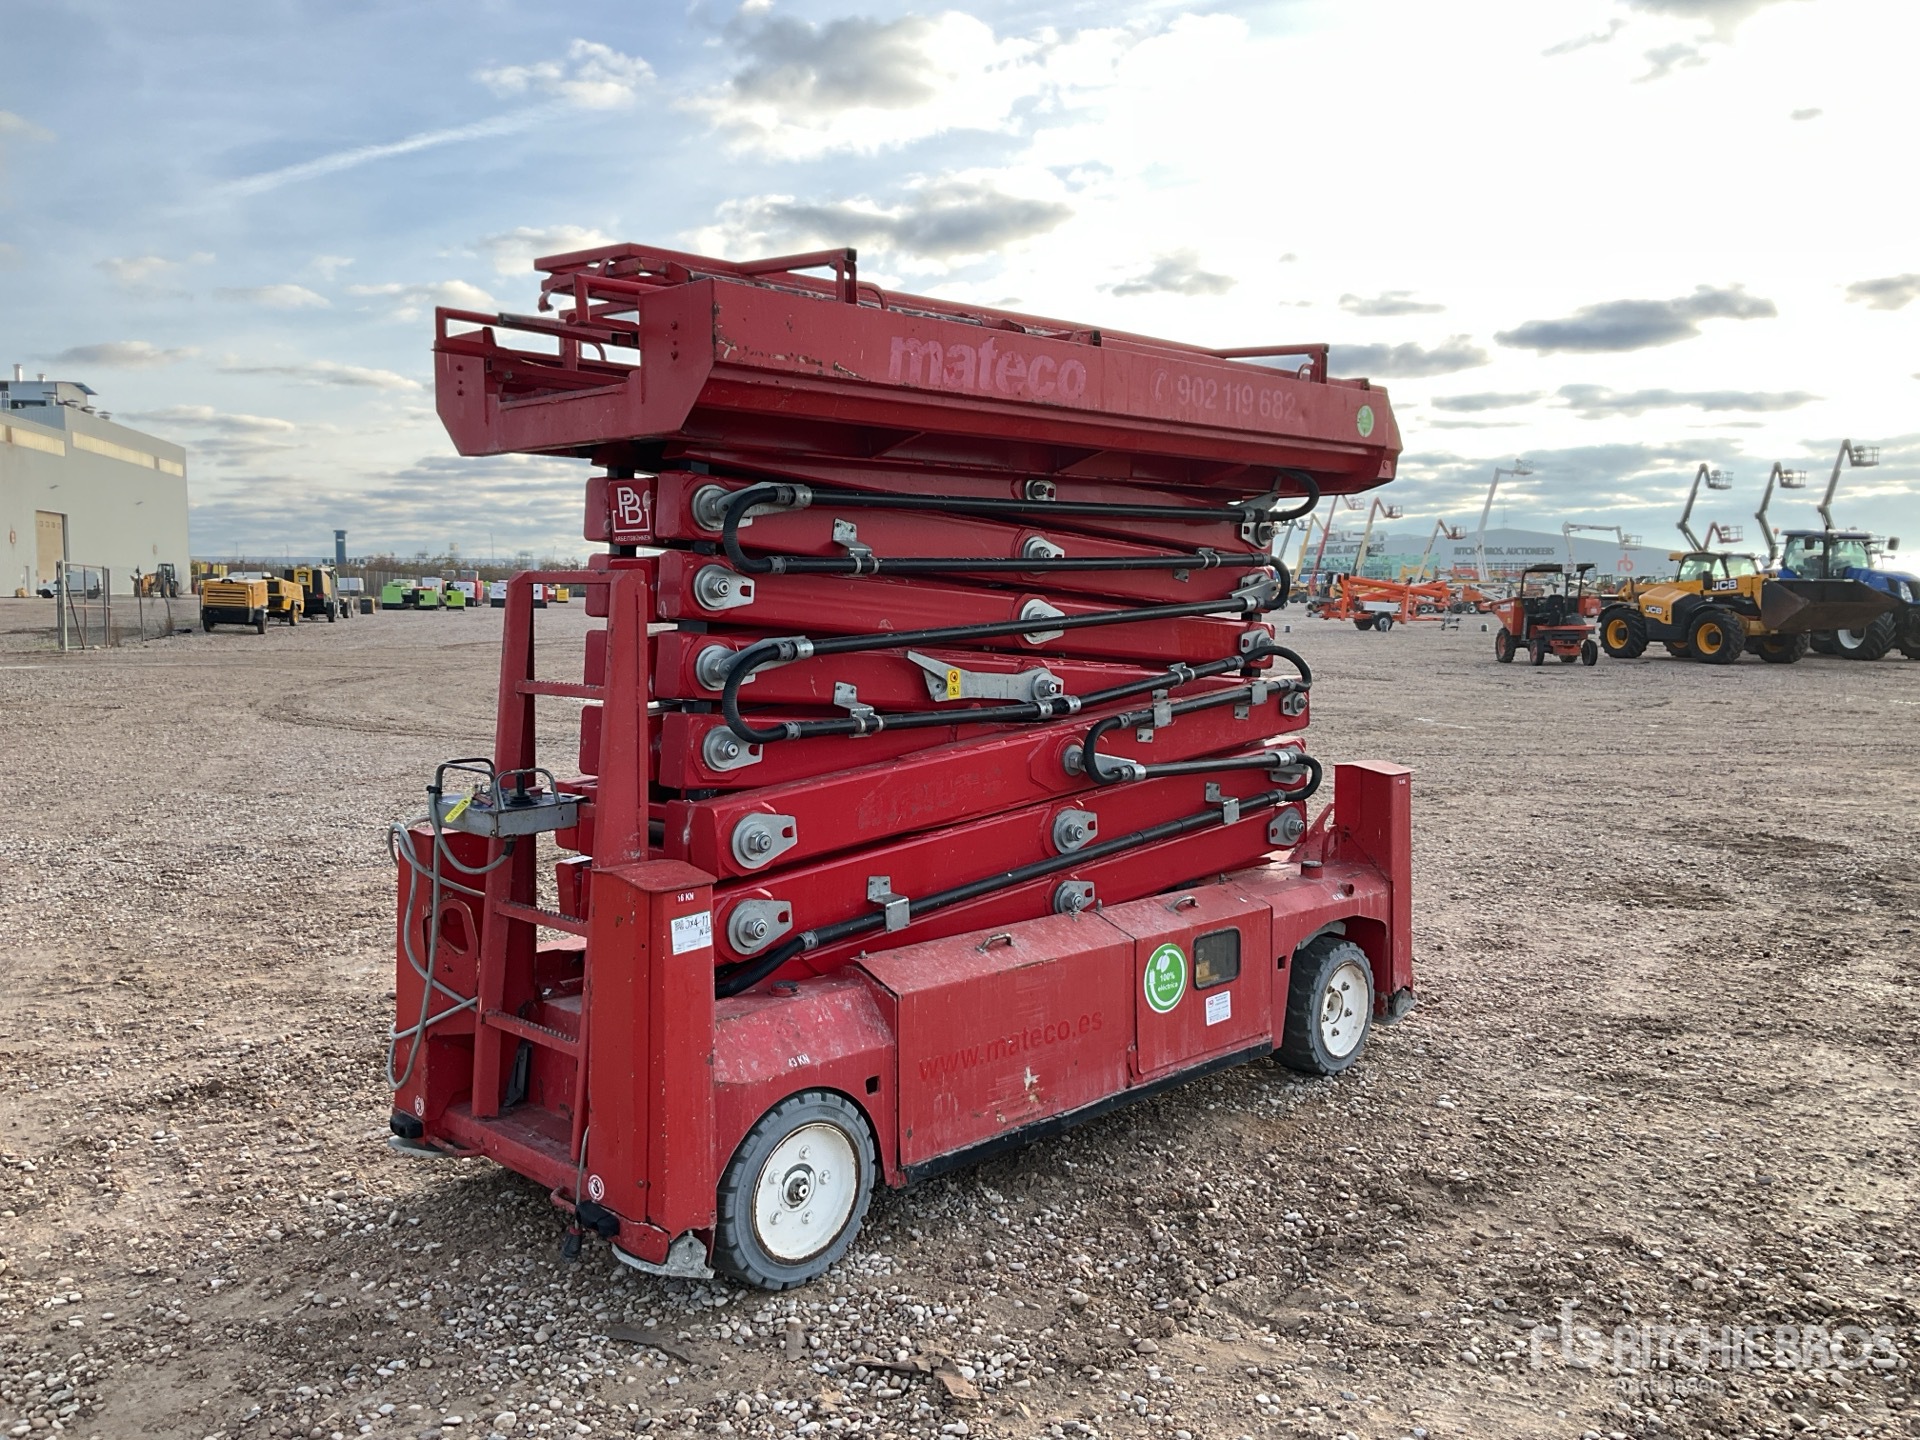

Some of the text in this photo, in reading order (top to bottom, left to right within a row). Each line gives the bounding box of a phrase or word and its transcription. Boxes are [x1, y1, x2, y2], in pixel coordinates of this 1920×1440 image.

[888, 336, 1086, 399] mateco
[1178, 374, 1296, 420] 902 119 682
[1711, 580, 1737, 591] JCB
[1645, 605, 1663, 614] JCB
[1160, 971, 1176, 982] 100%
[918, 1010, 1104, 1082] www.mateco.es
